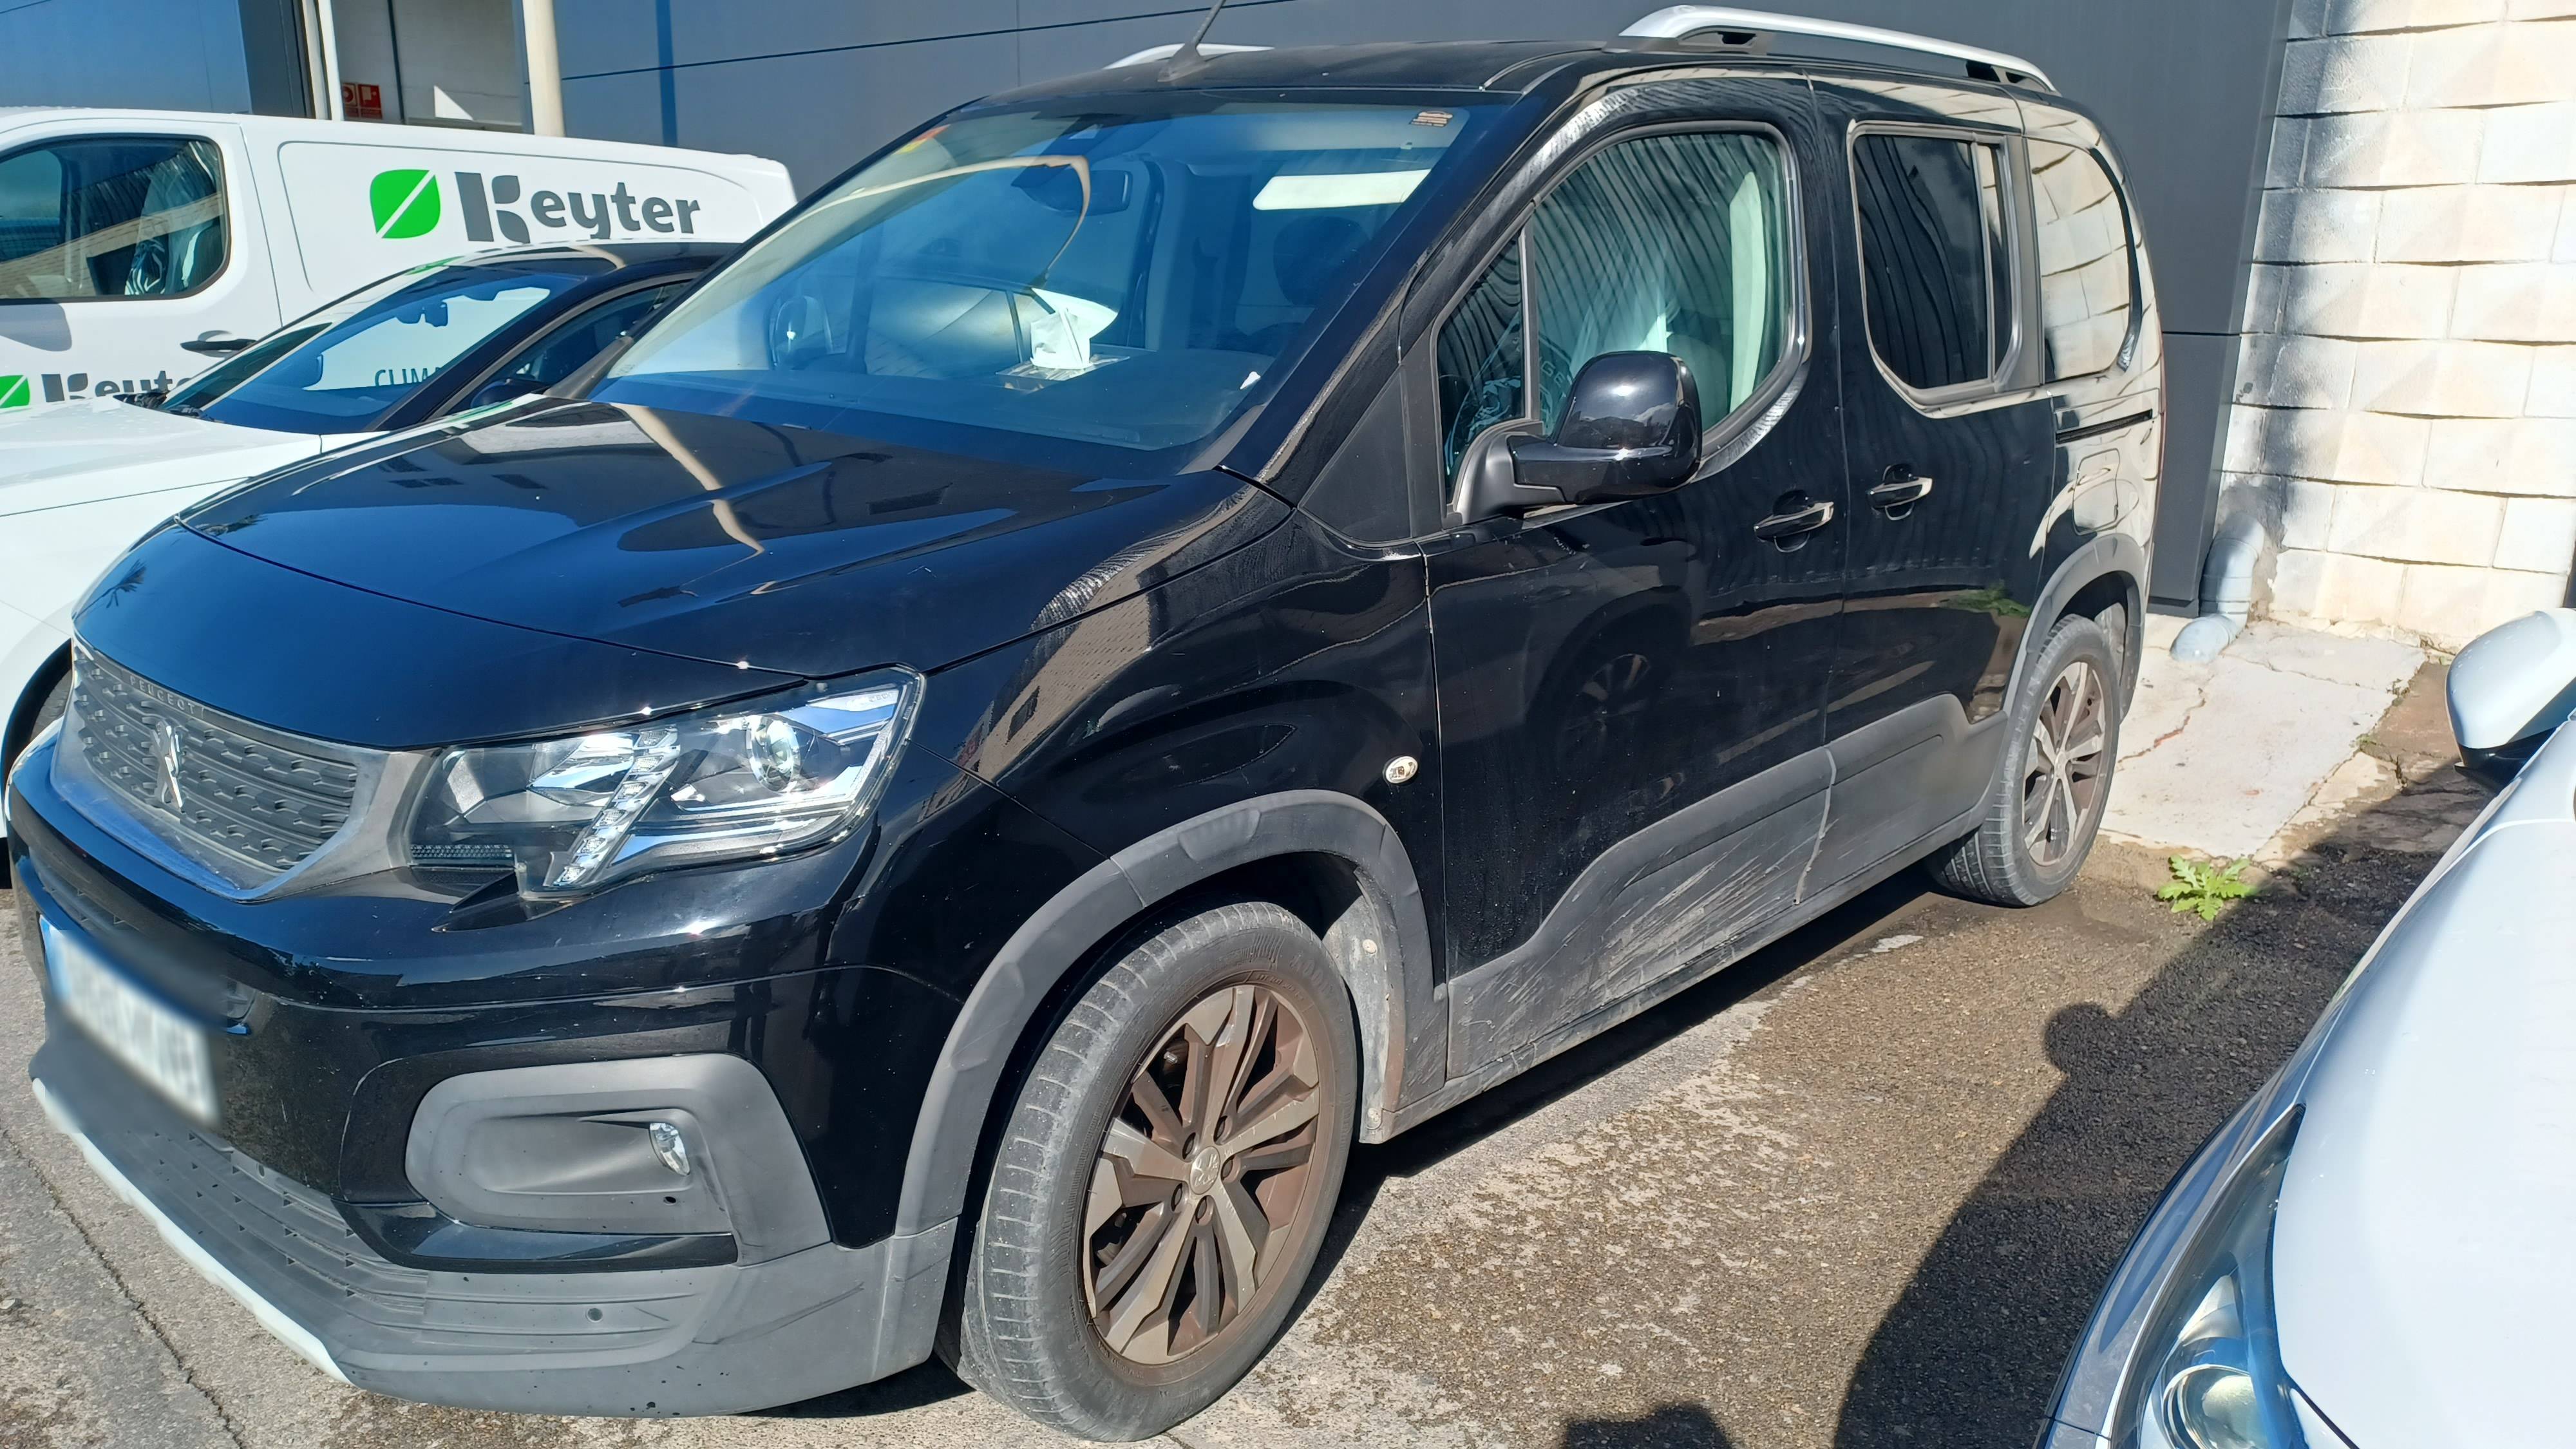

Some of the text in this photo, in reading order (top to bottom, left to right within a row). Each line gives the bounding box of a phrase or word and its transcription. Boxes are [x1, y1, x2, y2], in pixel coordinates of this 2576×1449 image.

[454, 171, 701, 244] Keyter
[375, 367, 442, 386] CLIM
[129, 675, 194, 714] PEUGEOT
